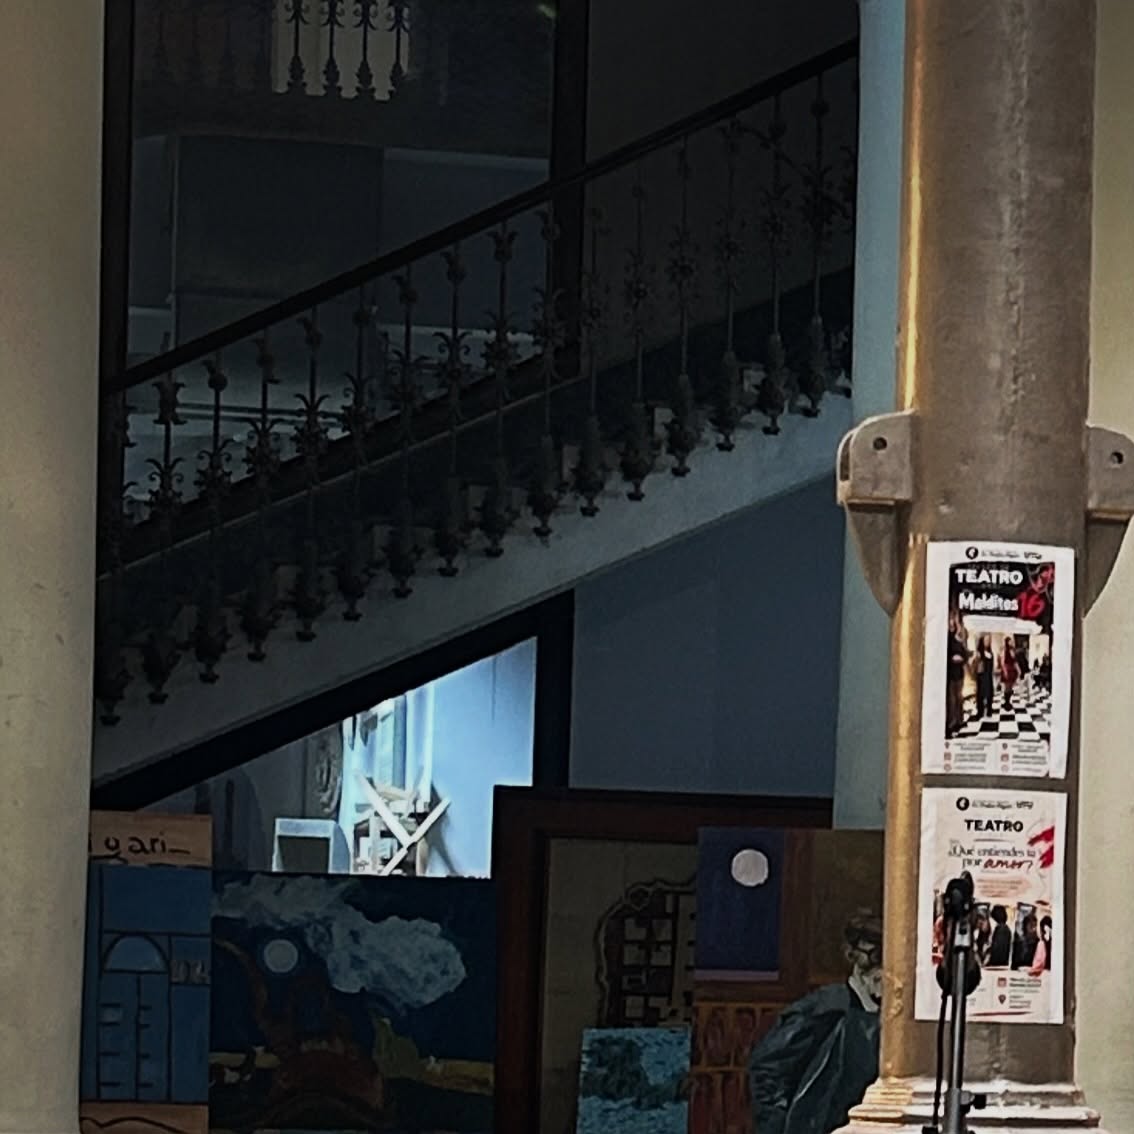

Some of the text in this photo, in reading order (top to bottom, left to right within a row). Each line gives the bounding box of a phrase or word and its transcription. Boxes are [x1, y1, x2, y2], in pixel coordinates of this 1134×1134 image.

[955, 569, 1024, 585] TEATRO
[958, 592, 1046, 618] Malditos 16
[964, 818, 1024, 832] TEATRO
